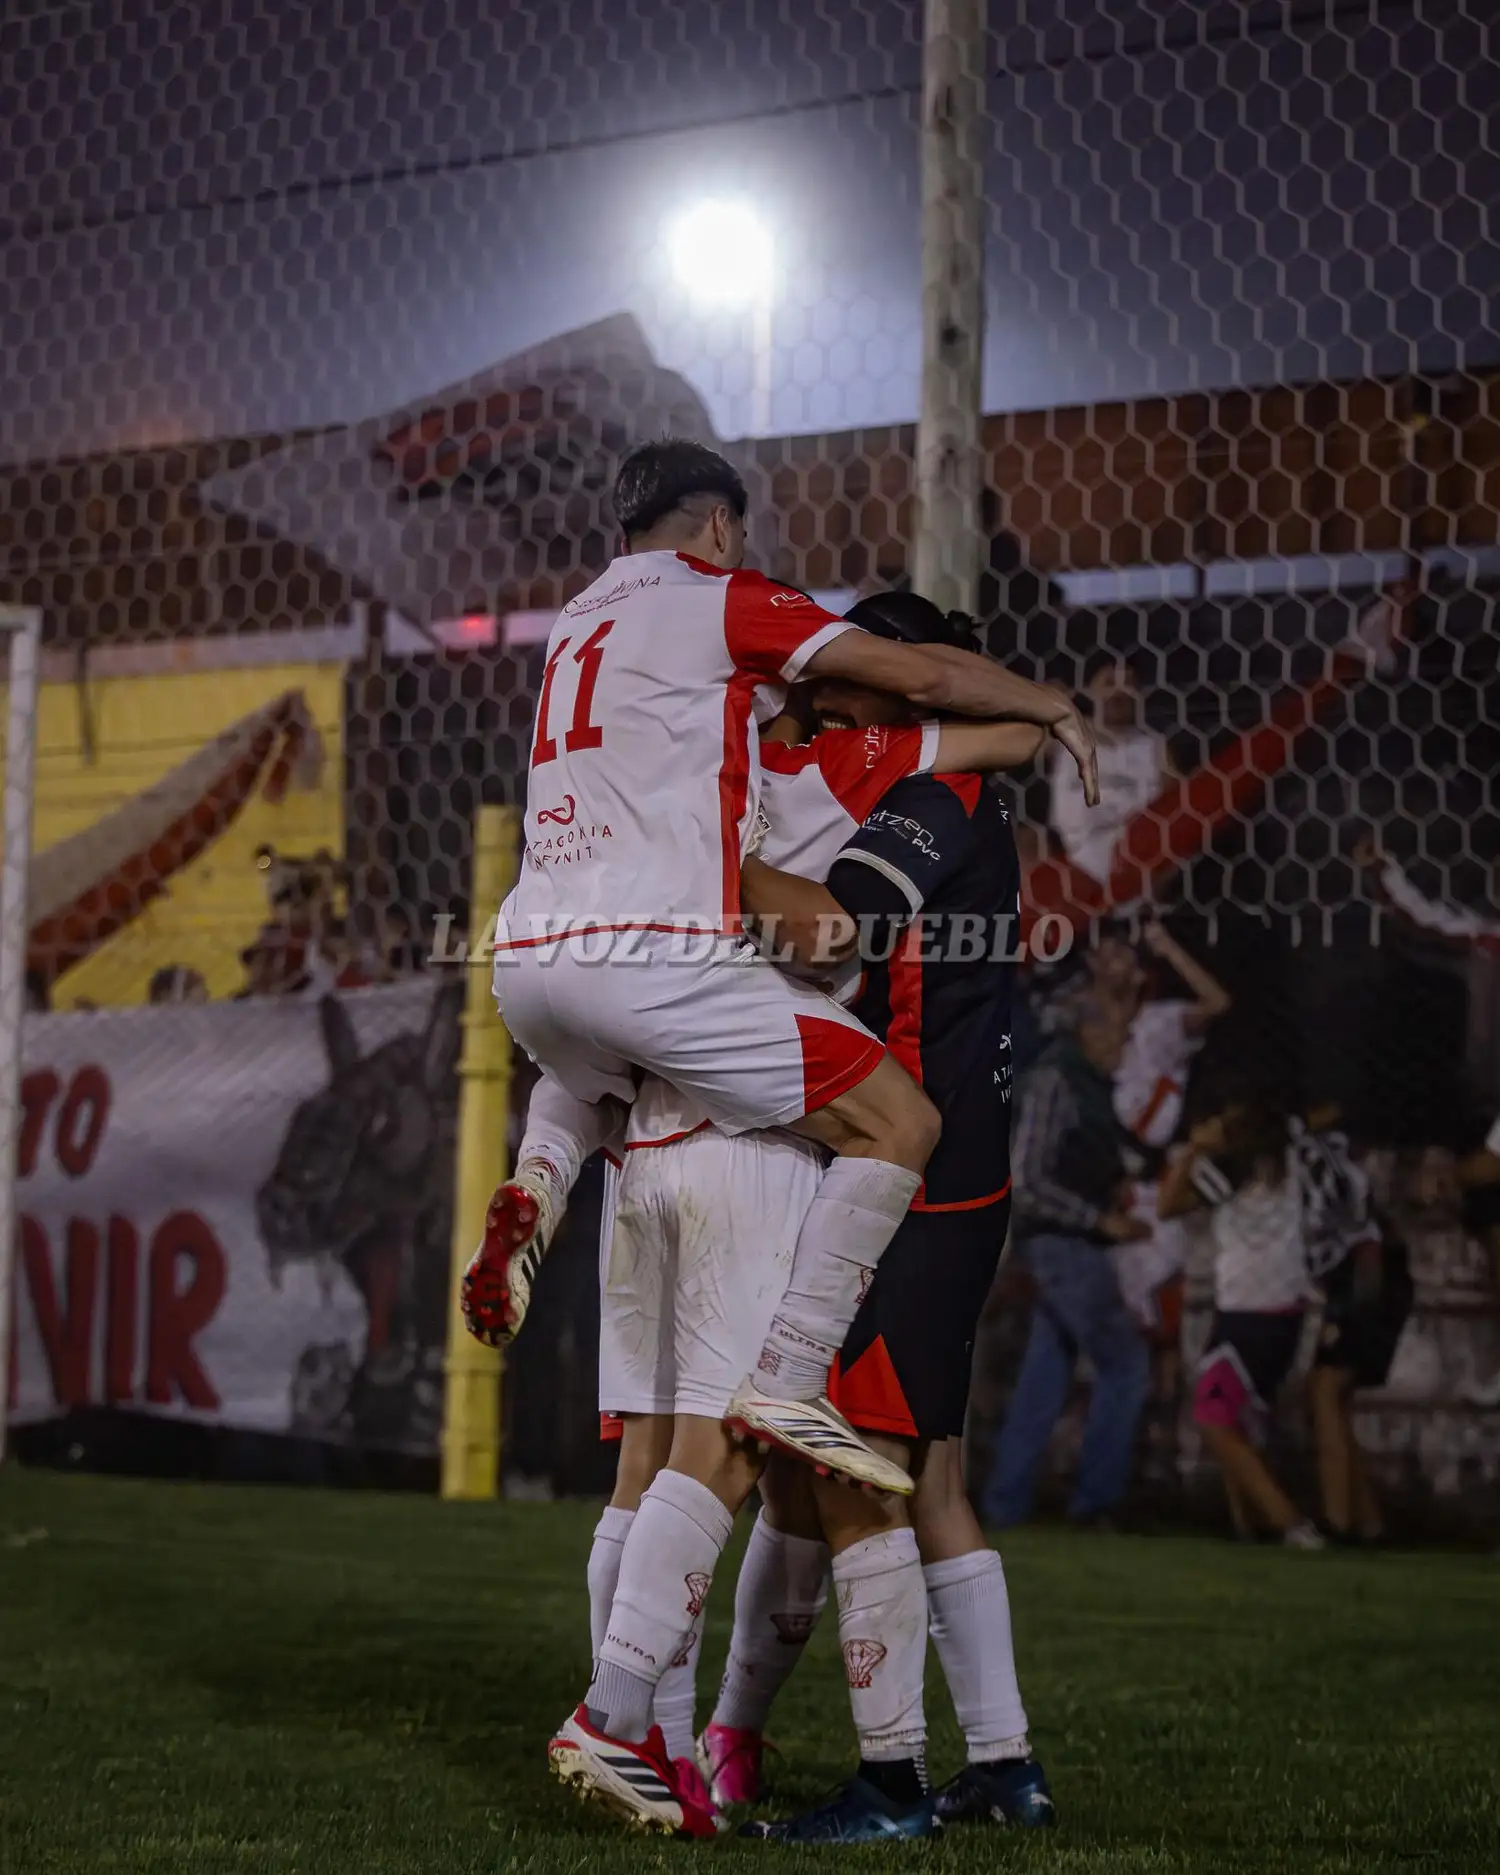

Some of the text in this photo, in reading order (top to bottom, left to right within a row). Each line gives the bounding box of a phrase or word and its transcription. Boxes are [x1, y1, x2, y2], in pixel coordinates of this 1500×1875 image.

[531, 620, 616, 769] 11
[912, 838, 941, 861] PVC
[7, 1208, 229, 1413] VIR
